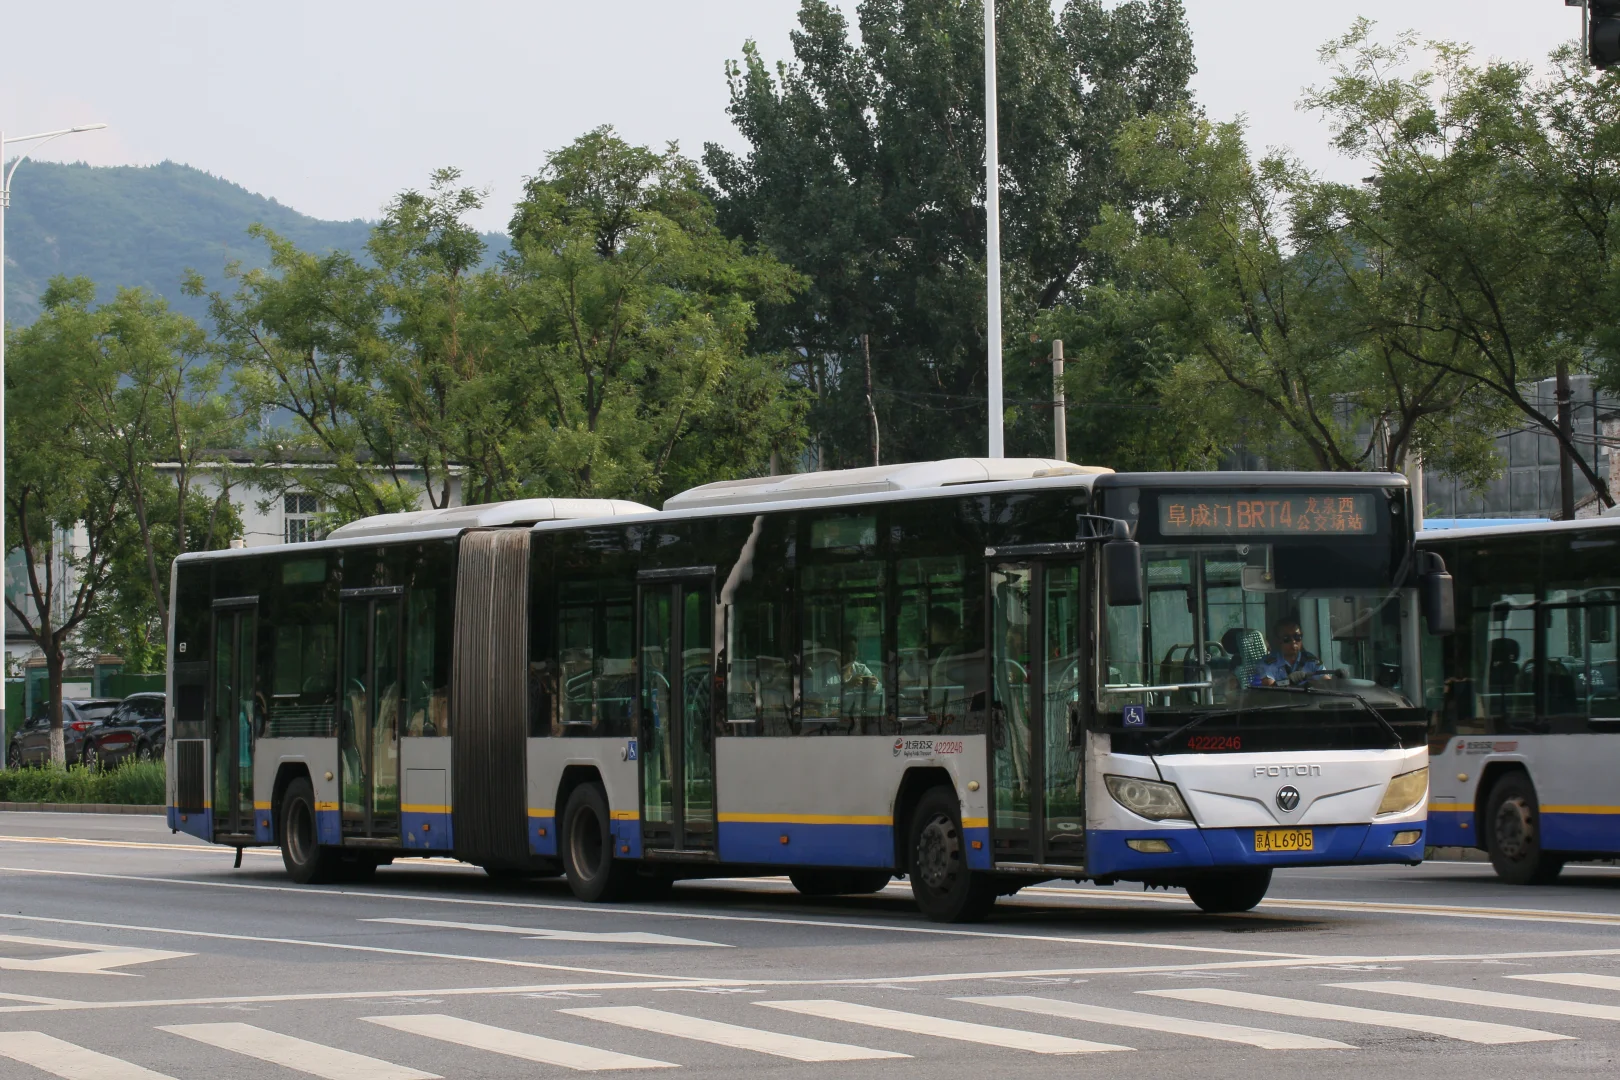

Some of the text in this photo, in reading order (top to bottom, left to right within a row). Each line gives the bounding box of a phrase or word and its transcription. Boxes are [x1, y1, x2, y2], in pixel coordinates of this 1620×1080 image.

[1304, 496, 1355, 514] 龙泉西
[1167, 501, 1292, 528] 阜成门 BRT4
[1297, 514, 1364, 532] 公交场站
[904, 740, 934, 750] 北京公交
[934, 741, 963, 754] 4222246
[1188, 736, 1241, 750] 4222246
[1253, 764, 1322, 777] FOTON
